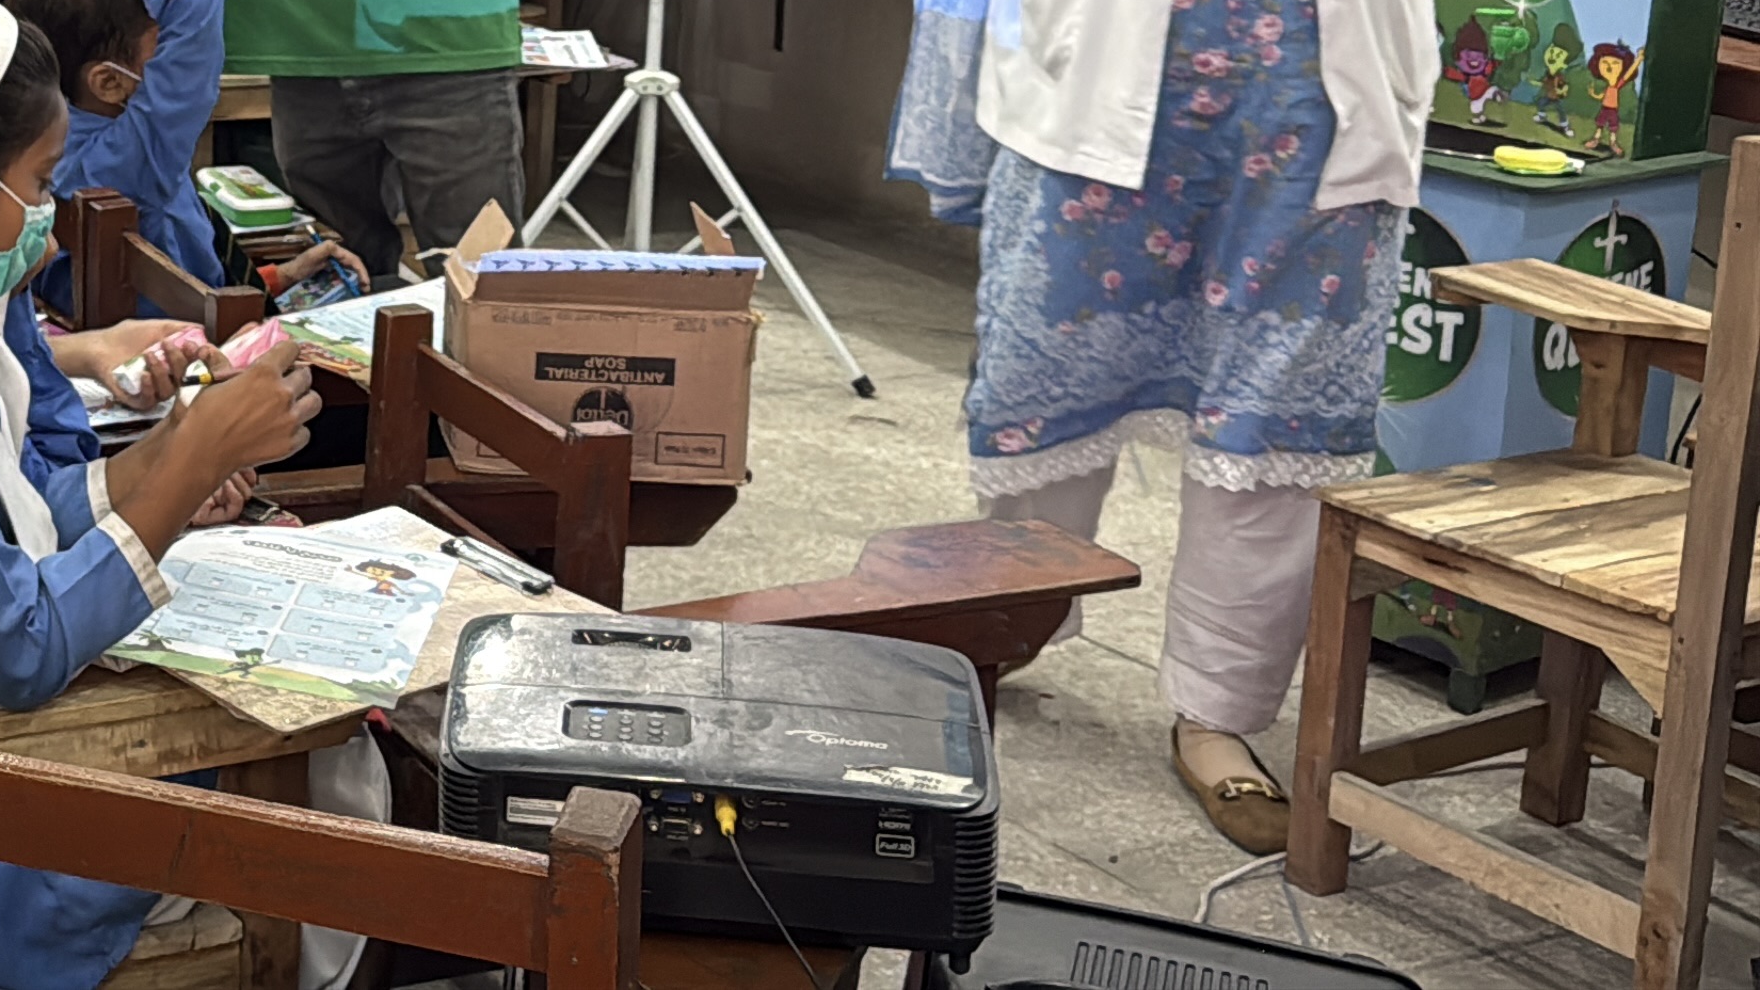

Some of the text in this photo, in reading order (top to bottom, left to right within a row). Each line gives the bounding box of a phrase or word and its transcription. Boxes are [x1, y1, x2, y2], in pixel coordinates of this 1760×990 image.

[583, 356, 627, 370] SOAP
[544, 366, 666, 384] ANTIBACTERIAL
[805, 732, 888, 750] Optoma
